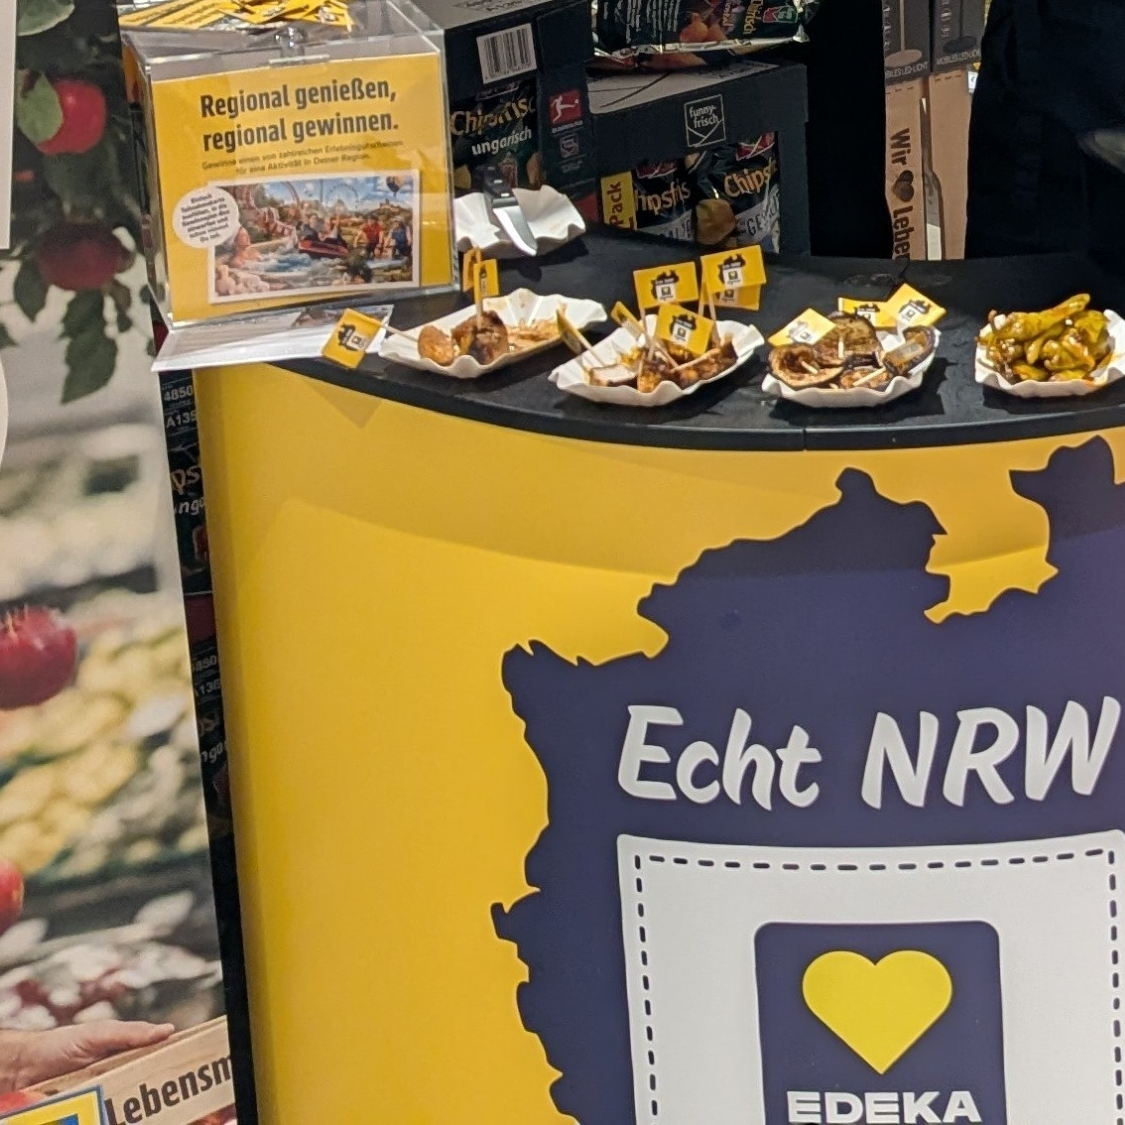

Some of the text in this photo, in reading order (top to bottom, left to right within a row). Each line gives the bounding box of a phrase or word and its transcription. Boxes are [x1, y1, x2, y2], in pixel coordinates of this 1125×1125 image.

[200, 77, 397, 119] Regional genießen,
[203, 112, 399, 153] regional gewinnen.
[471, 125, 533, 156] ungarisch
[693, 113, 720, 129] frisch
[889, 127, 911, 166] Wir
[616, 695, 1122, 812] Echt NRW
[786, 1089, 983, 1125] EDEKA
